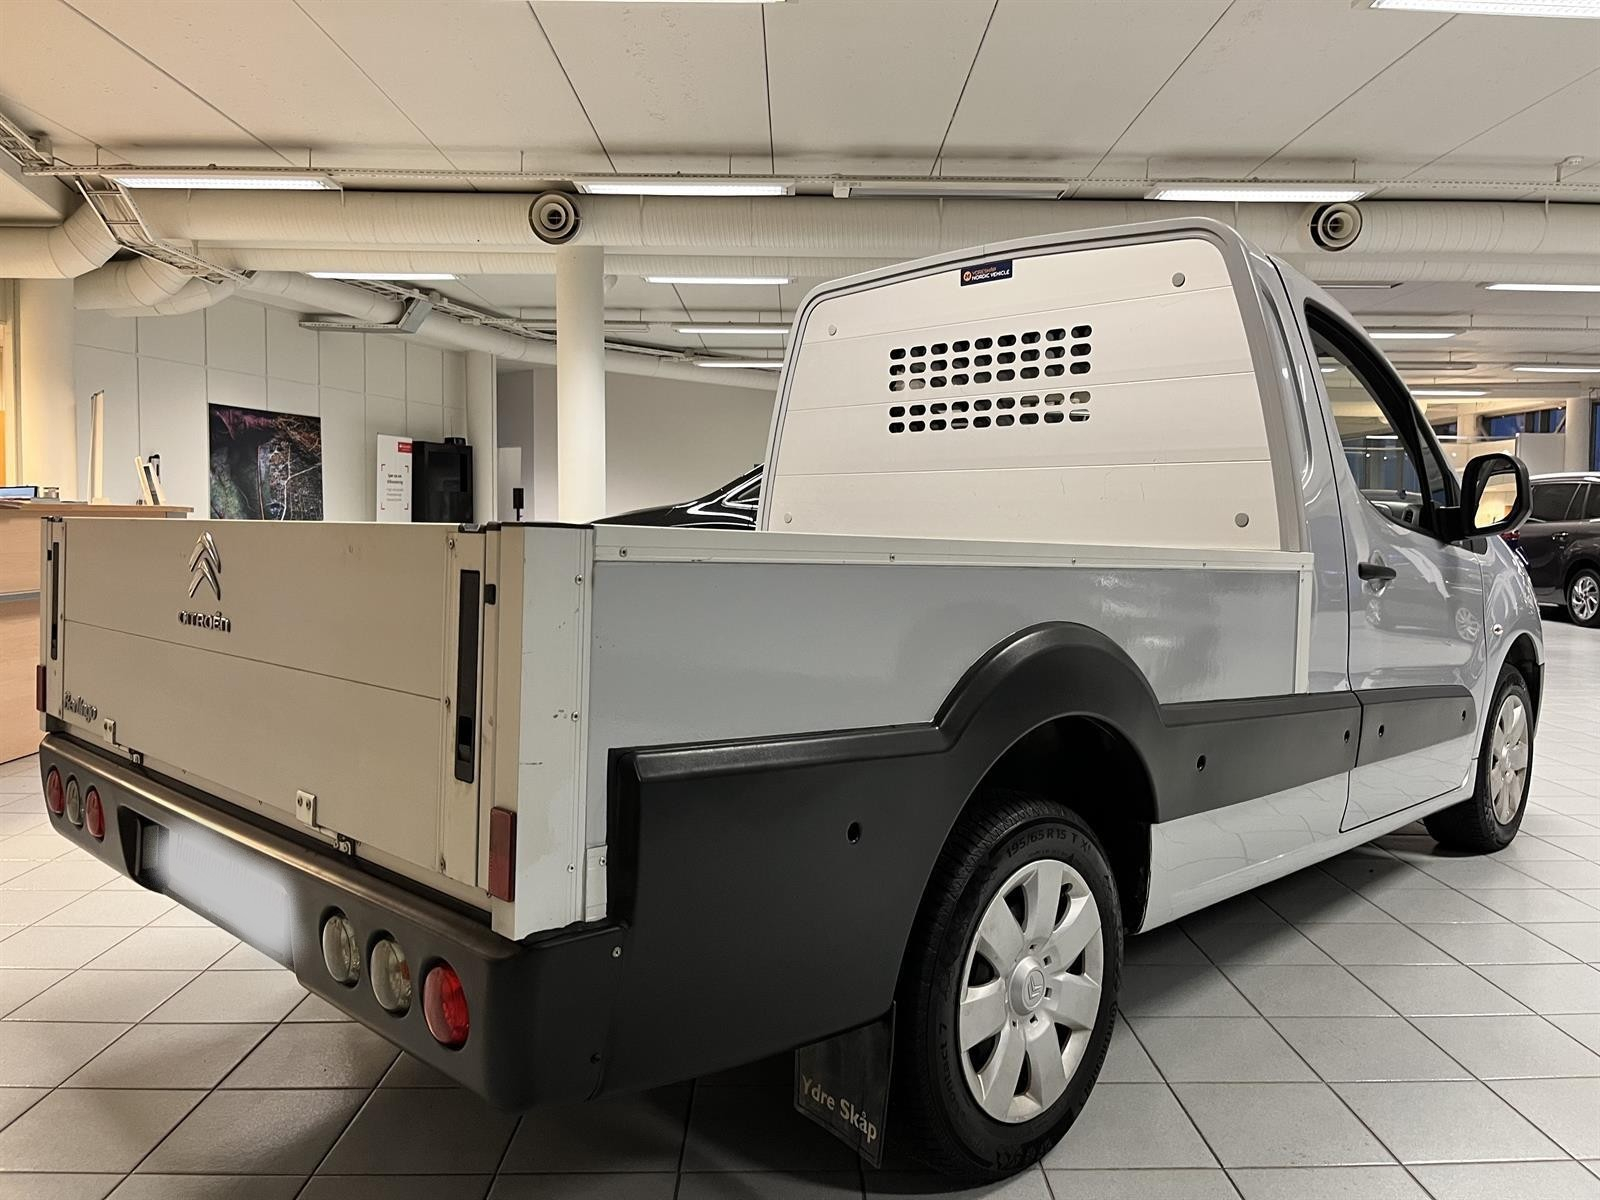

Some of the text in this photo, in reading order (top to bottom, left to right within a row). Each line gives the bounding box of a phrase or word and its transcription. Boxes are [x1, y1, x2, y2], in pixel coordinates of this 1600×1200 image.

[972, 269, 1010, 281] NORDIC VEHICLE
[801, 1073, 877, 1144] Ydre Skåp
